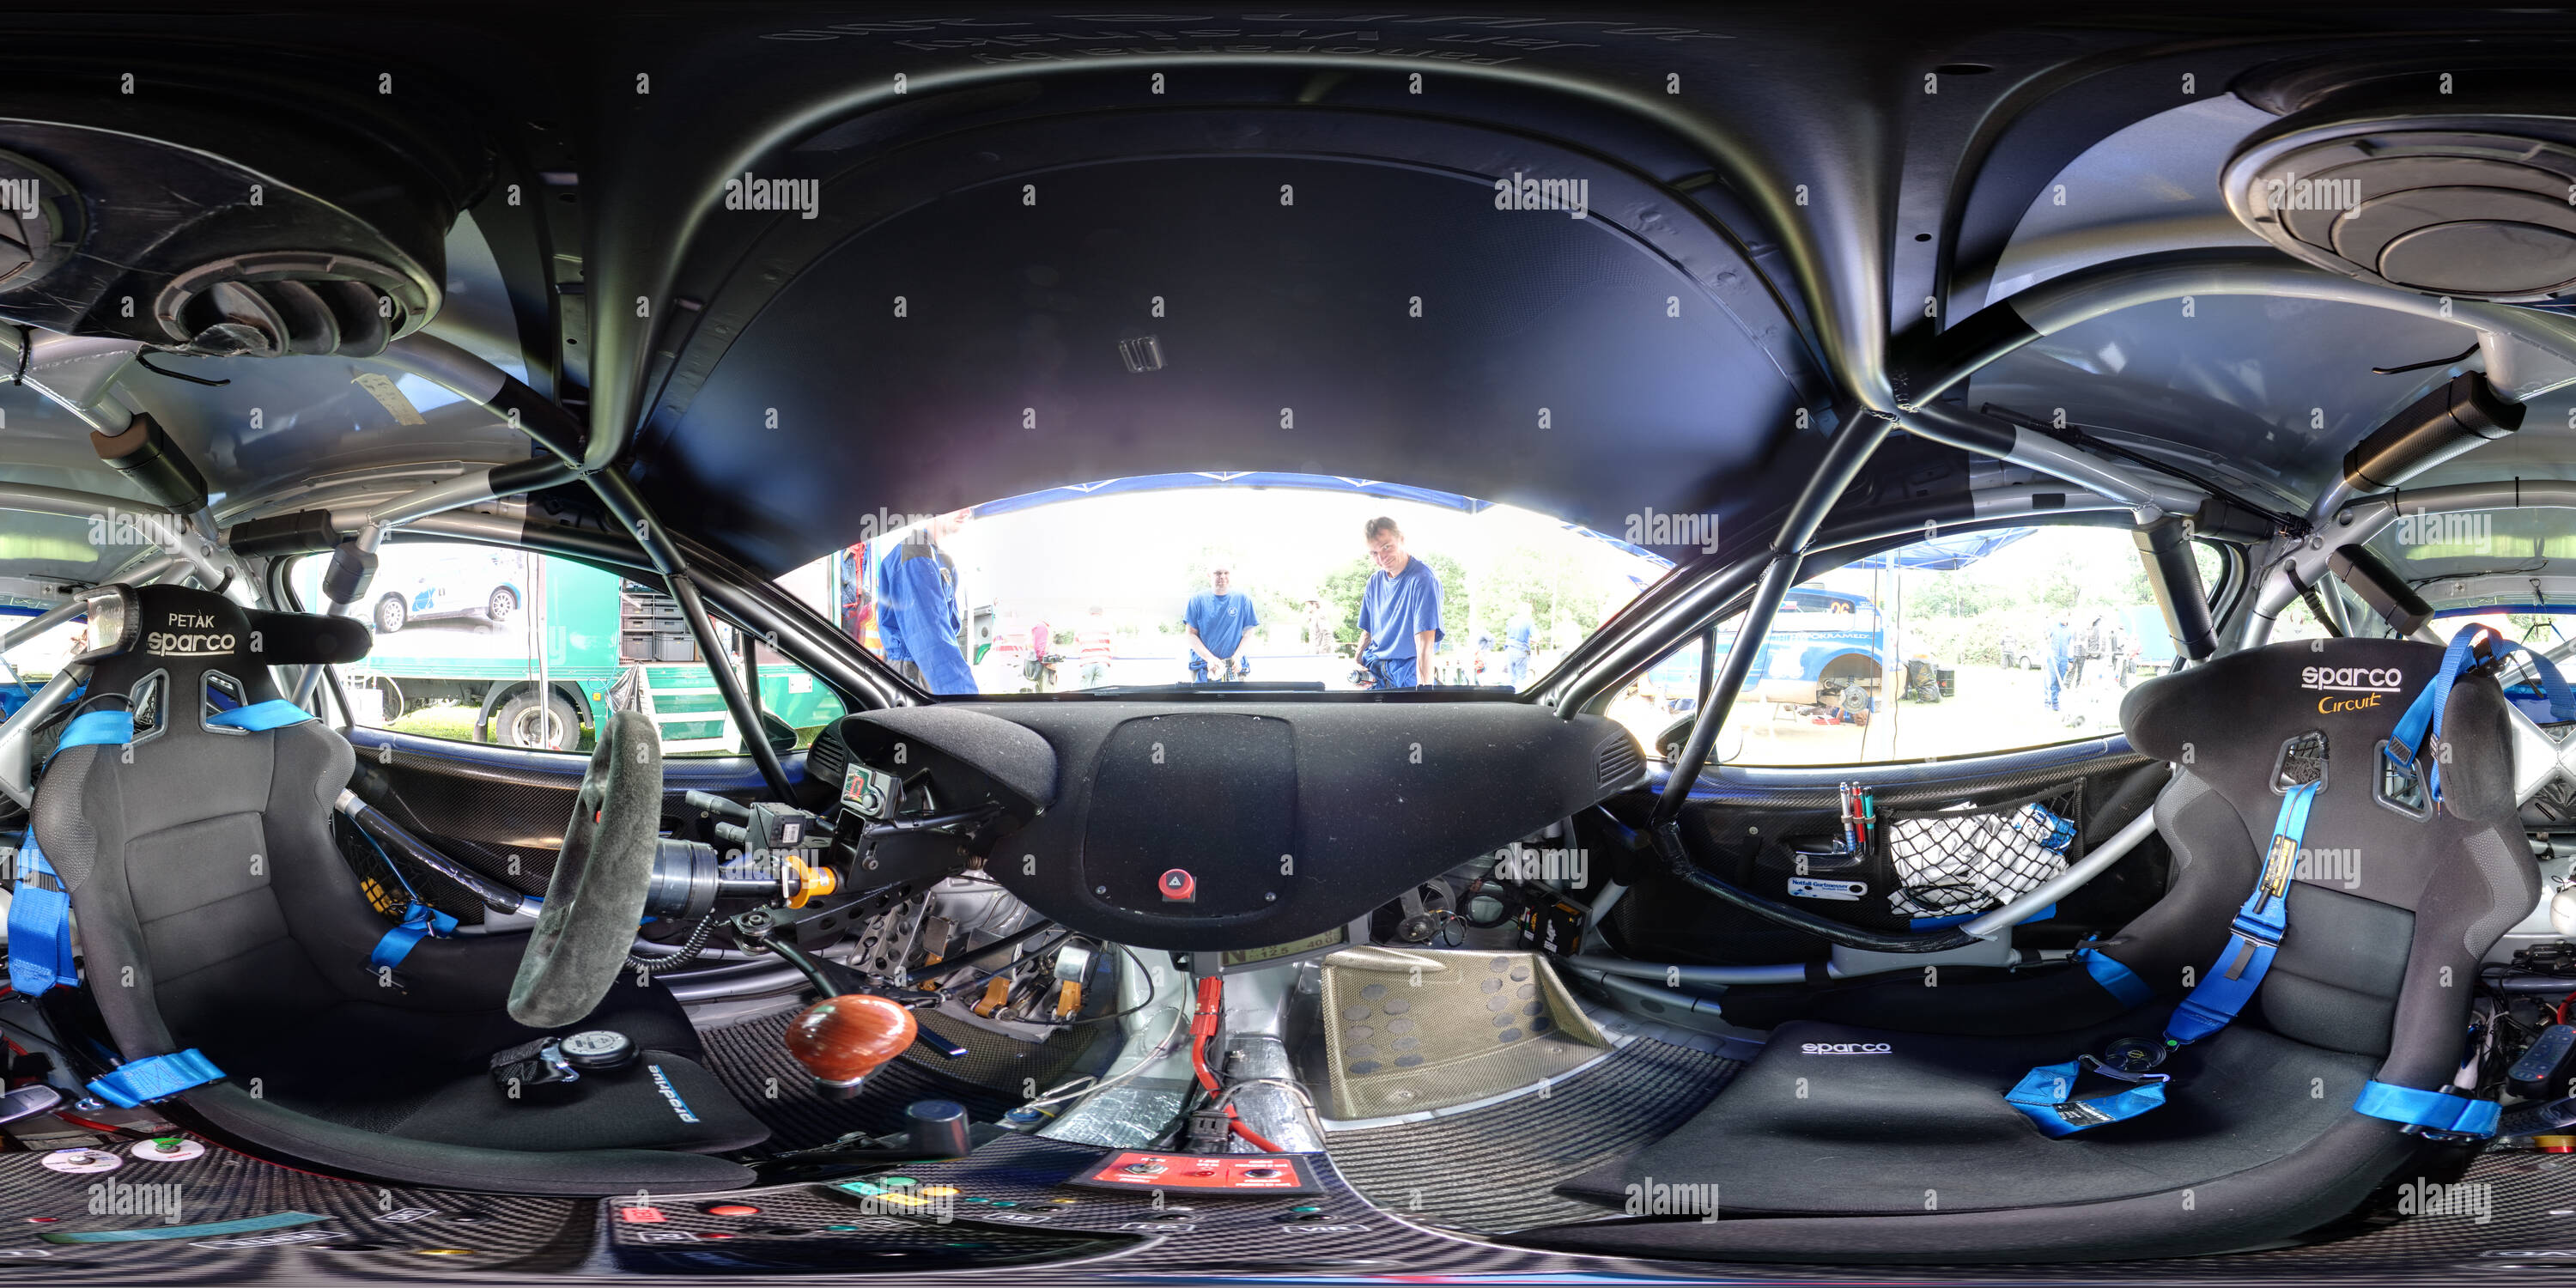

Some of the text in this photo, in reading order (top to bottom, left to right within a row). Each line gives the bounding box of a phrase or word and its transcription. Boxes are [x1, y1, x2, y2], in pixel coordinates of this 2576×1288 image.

[147, 631, 235, 656] sparco
[2301, 666, 2402, 692] sparco
[2318, 691, 2382, 714] Circuit
[1801, 1042, 1893, 1055] sparco
[647, 1065, 701, 1125] prodrive
